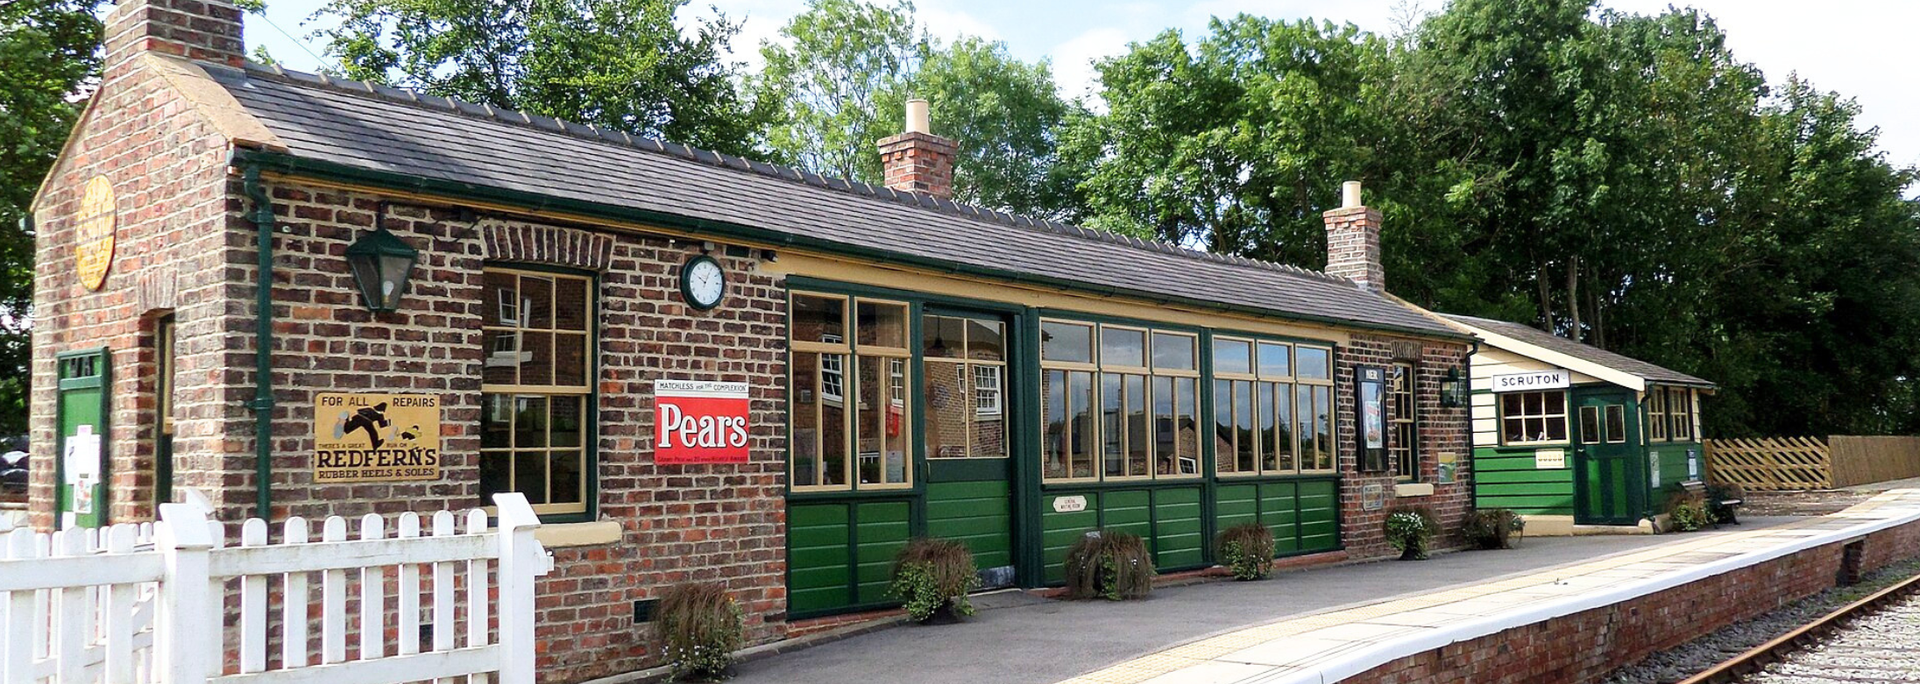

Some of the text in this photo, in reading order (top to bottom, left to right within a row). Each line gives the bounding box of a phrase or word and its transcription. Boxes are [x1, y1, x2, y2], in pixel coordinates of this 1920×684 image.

[1366, 369, 1378, 379] NER
[1502, 374, 1559, 386] SCRUTON
[321, 397, 435, 407] FOR ALL REPAIRS
[658, 403, 748, 448] Pears
[317, 449, 437, 468] REDFERN'S
[318, 470, 359, 479] RUBBER
[361, 469, 393, 478] HEELS
[405, 468, 435, 477] SOLES
